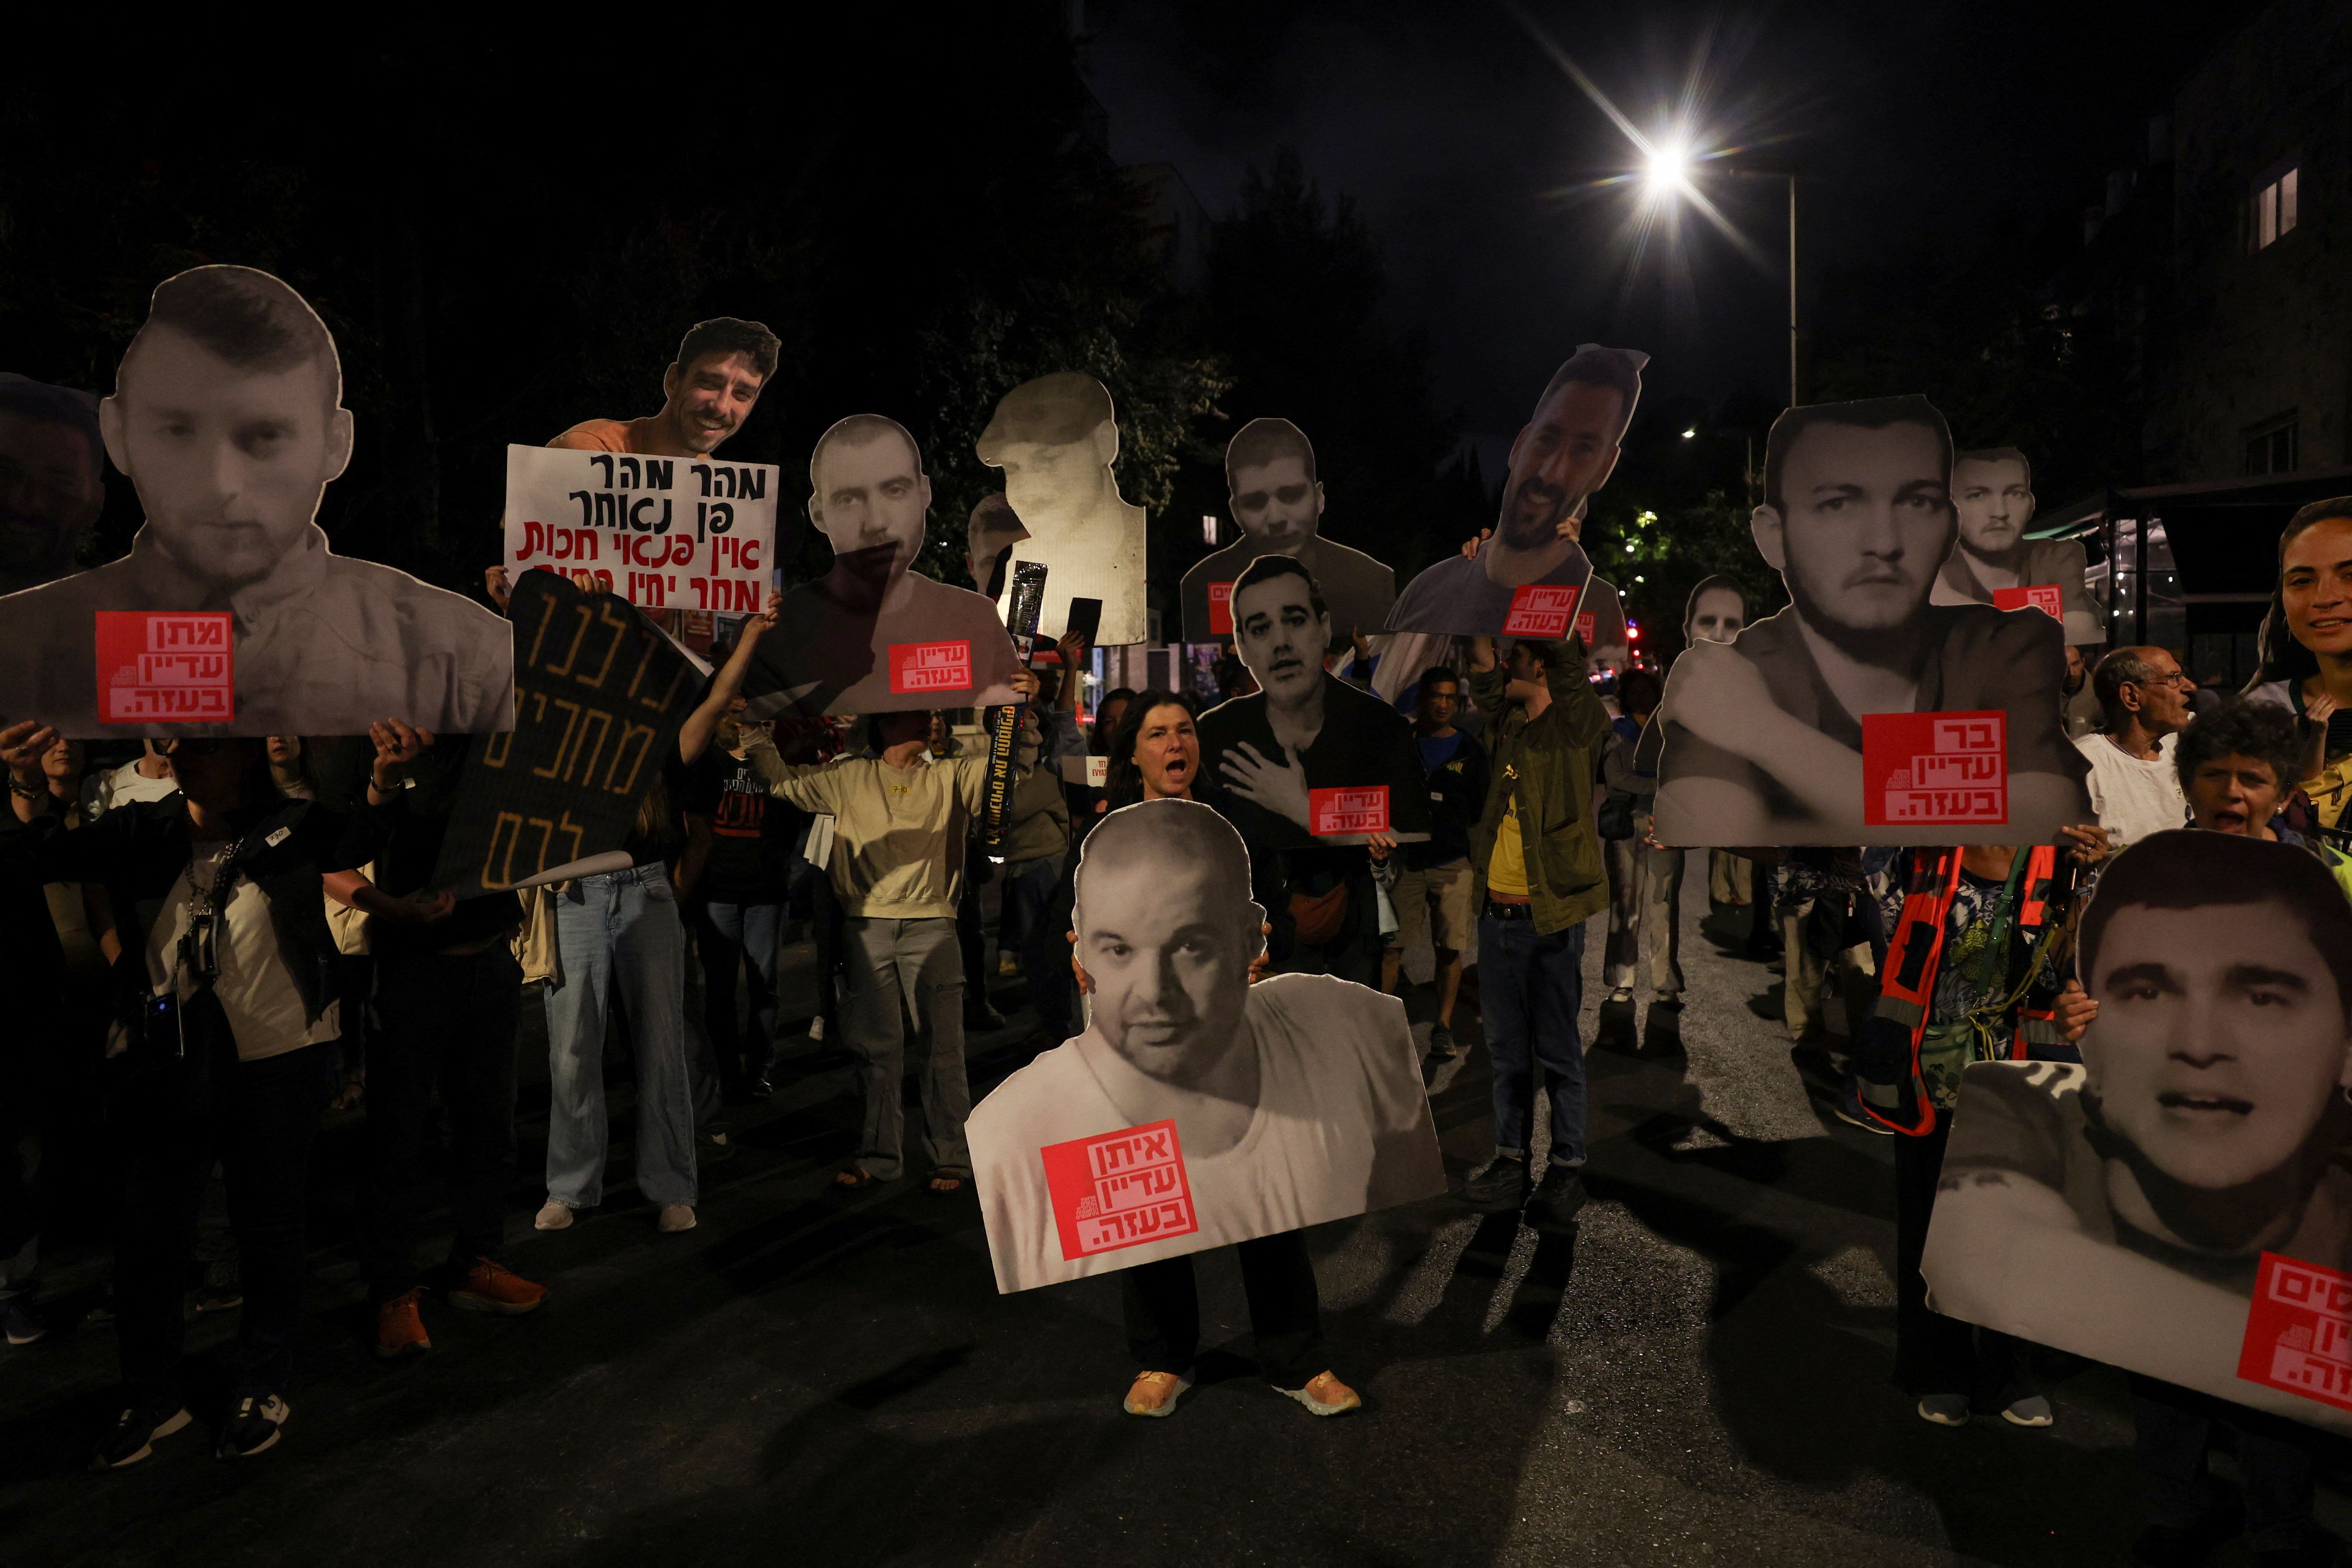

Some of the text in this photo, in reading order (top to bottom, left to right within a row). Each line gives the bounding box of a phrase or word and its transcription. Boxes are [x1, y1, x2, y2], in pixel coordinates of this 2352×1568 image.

[591, 455, 765, 500] מהר מהר
[697, 502, 733, 543] פן
[516, 521, 759, 576] אין פנאי חכות
[691, 577, 759, 612] מחר
[1530, 592, 1572, 609] עדיין
[2032, 591, 2056, 603] בר
[1513, 614, 1563, 631] בעזה.
[157, 622, 222, 649] מתן
[144, 656, 223, 682] עדיין
[920, 647, 964, 666] עדיין
[910, 668, 966, 685] בעזה.
[124, 690, 226, 712] בעזה.
[1944, 724, 1995, 749] בר
[1918, 756, 1996, 785] עדיין
[1338, 793, 1381, 811] עדיין
[1899, 792, 1998, 815] בעזה.
[1327, 813, 1382, 829] בעזה.
[1095, 1132, 1169, 1176] איתן
[1101, 1166, 1176, 1209] עדיין
[1093, 1202, 1186, 1245] בעזה.
